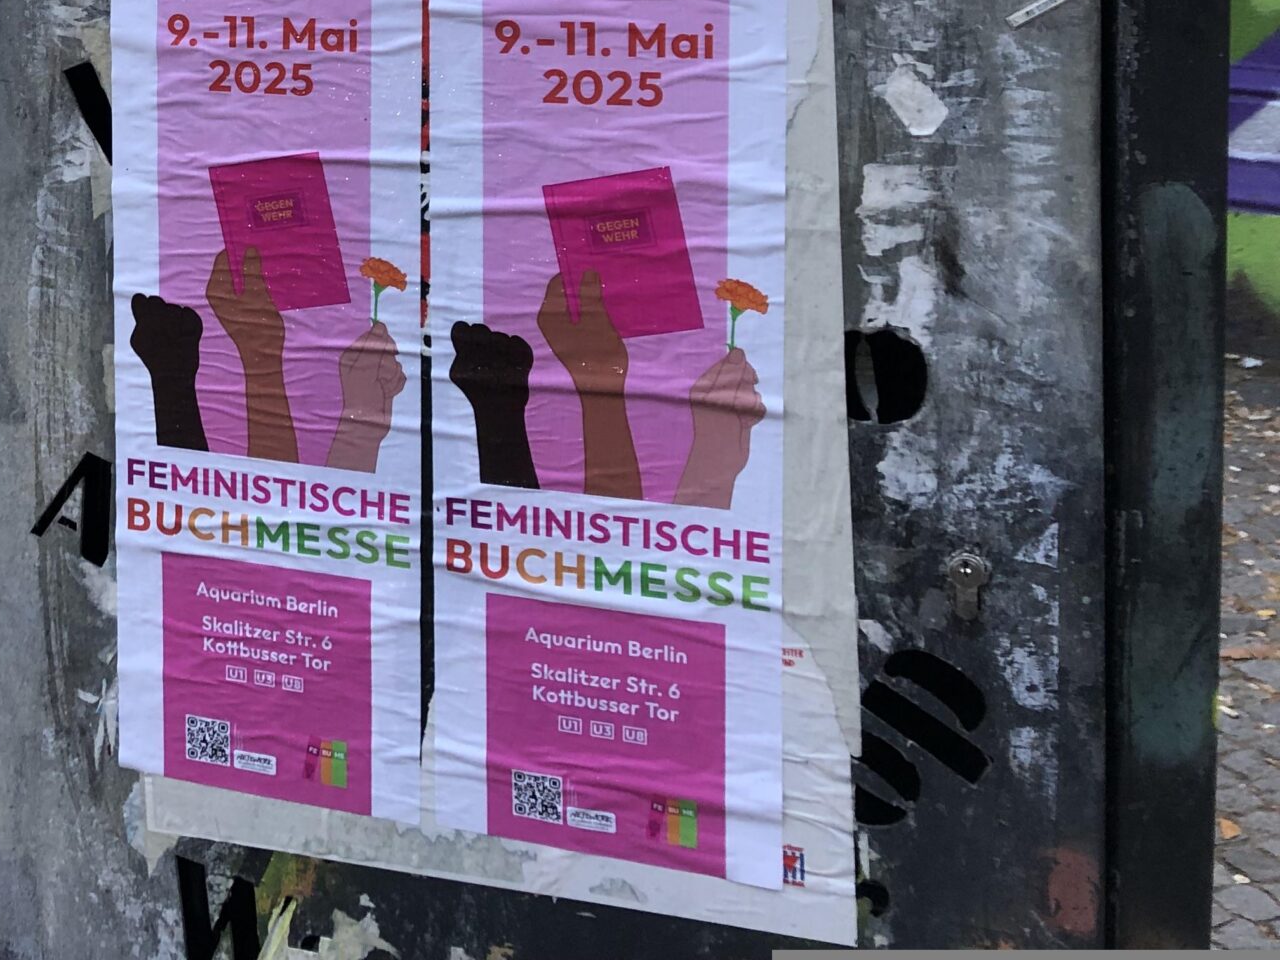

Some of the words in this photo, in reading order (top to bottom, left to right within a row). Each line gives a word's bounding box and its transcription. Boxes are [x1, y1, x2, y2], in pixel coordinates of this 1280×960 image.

[166, 14, 268, 51] 9.-11.
[282, 16, 359, 53] Mai
[493, 19, 612, 57] 9.-11.
[627, 21, 715, 60] Mai
[208, 60, 315, 97] 2025
[541, 69, 664, 108] 2025
[256, 199, 293, 211] GEGEN
[261, 210, 293, 222] WEHR
[597, 218, 639, 232] GEGEN
[602, 230, 639, 242] WEHR
[127, 458, 411, 525] FEMINISTISCHE
[127, 497, 412, 569] BUCHMESSE
[445, 497, 771, 564] FEMINISTISCHE
[445, 538, 771, 612] BUCHMESSE
[196, 581, 281, 610] Aquarium
[286, 596, 338, 618] Berlin
[202, 616, 280, 642] Skalitzer
[285, 629, 317, 649] Str.
[321, 636, 332, 650] 6
[524, 627, 622, 655] Aquarium
[628, 640, 688, 664] Berlin
[203, 638, 297, 666] Kottbusser
[301, 652, 331, 671] Tor
[229, 668, 244, 680] U1
[531, 662, 621, 690] Skalitzer
[626, 676, 663, 697] Str.
[668, 684, 681, 700] 6
[532, 685, 640, 715] Kottbusser
[644, 702, 680, 722] Tor
[562, 718, 578, 731] U1
[592, 724, 612, 736] U3
[625, 728, 645, 742] U8
